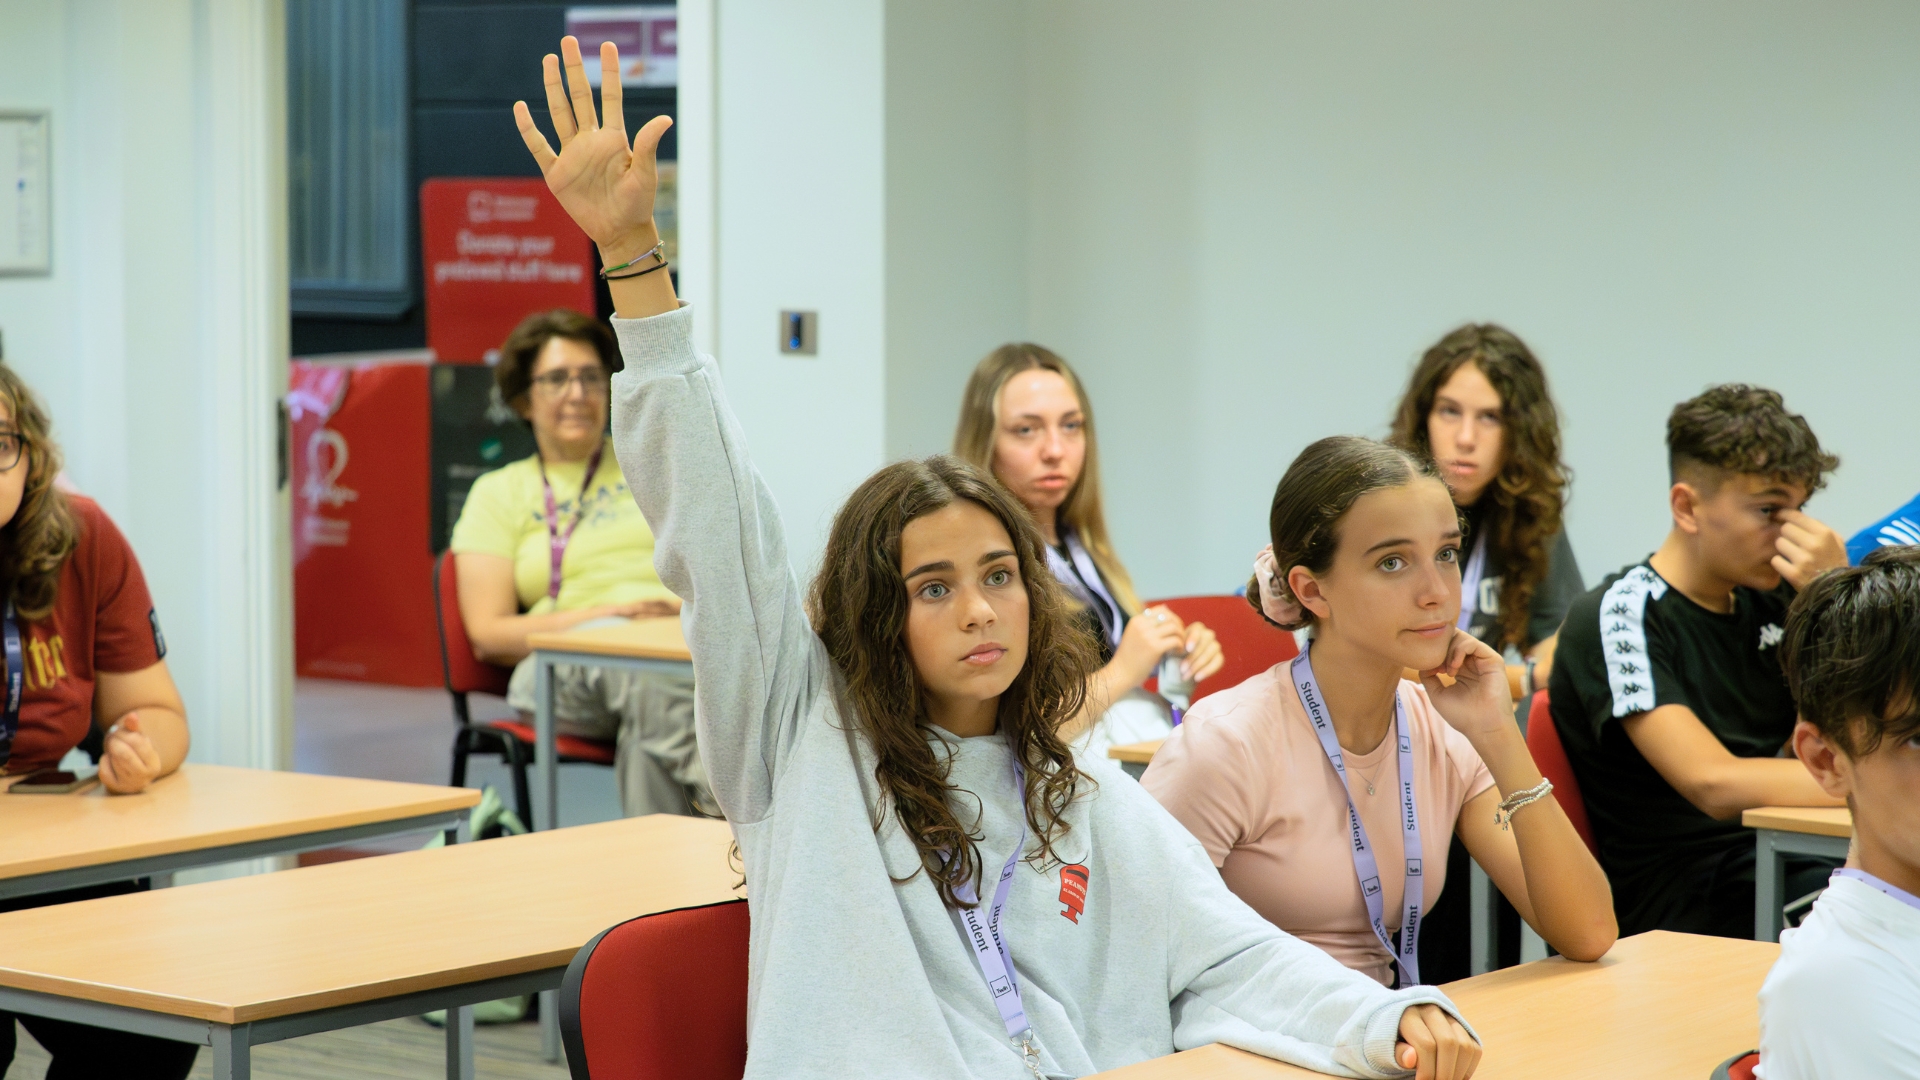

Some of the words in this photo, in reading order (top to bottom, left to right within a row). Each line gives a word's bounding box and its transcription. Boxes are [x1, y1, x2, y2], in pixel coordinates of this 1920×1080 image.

[1301, 681, 1326, 729] Student
[1405, 781, 1416, 830] Student
[966, 906, 989, 953] tudent
[1404, 905, 1418, 954] Student
